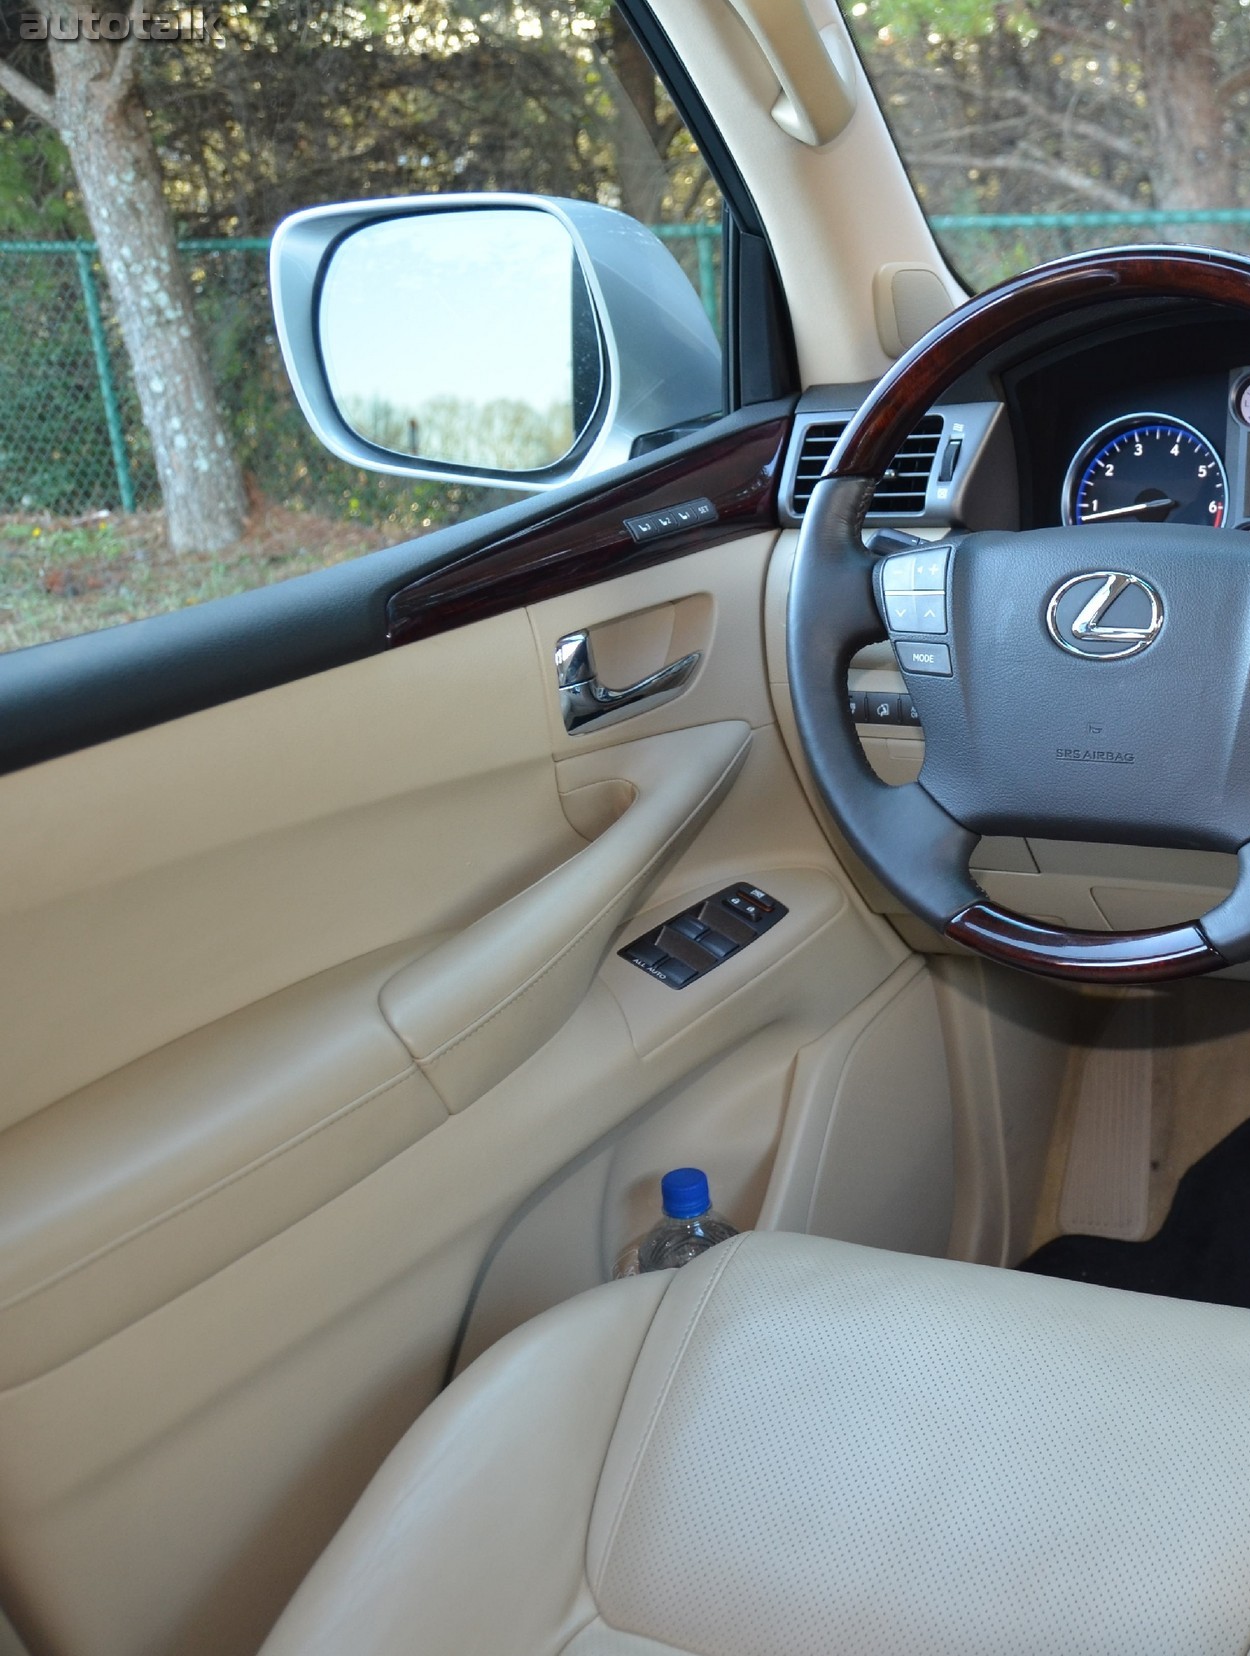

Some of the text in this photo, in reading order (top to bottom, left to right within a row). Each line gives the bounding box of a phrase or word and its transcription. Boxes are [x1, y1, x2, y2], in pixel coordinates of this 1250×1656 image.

[1134, 444, 1143, 456] 3
[1170, 444, 1180, 456] 4
[1104, 464, 1114, 476] 2
[1198, 465, 1207, 478] 5
[1092, 500, 1098, 512] 1
[1208, 501, 1218, 514] 6
[912, 652, 935, 664] MODE
[1056, 748, 1136, 762] SRS AIRBAG
[632, 958, 667, 980] ALL AUTO
